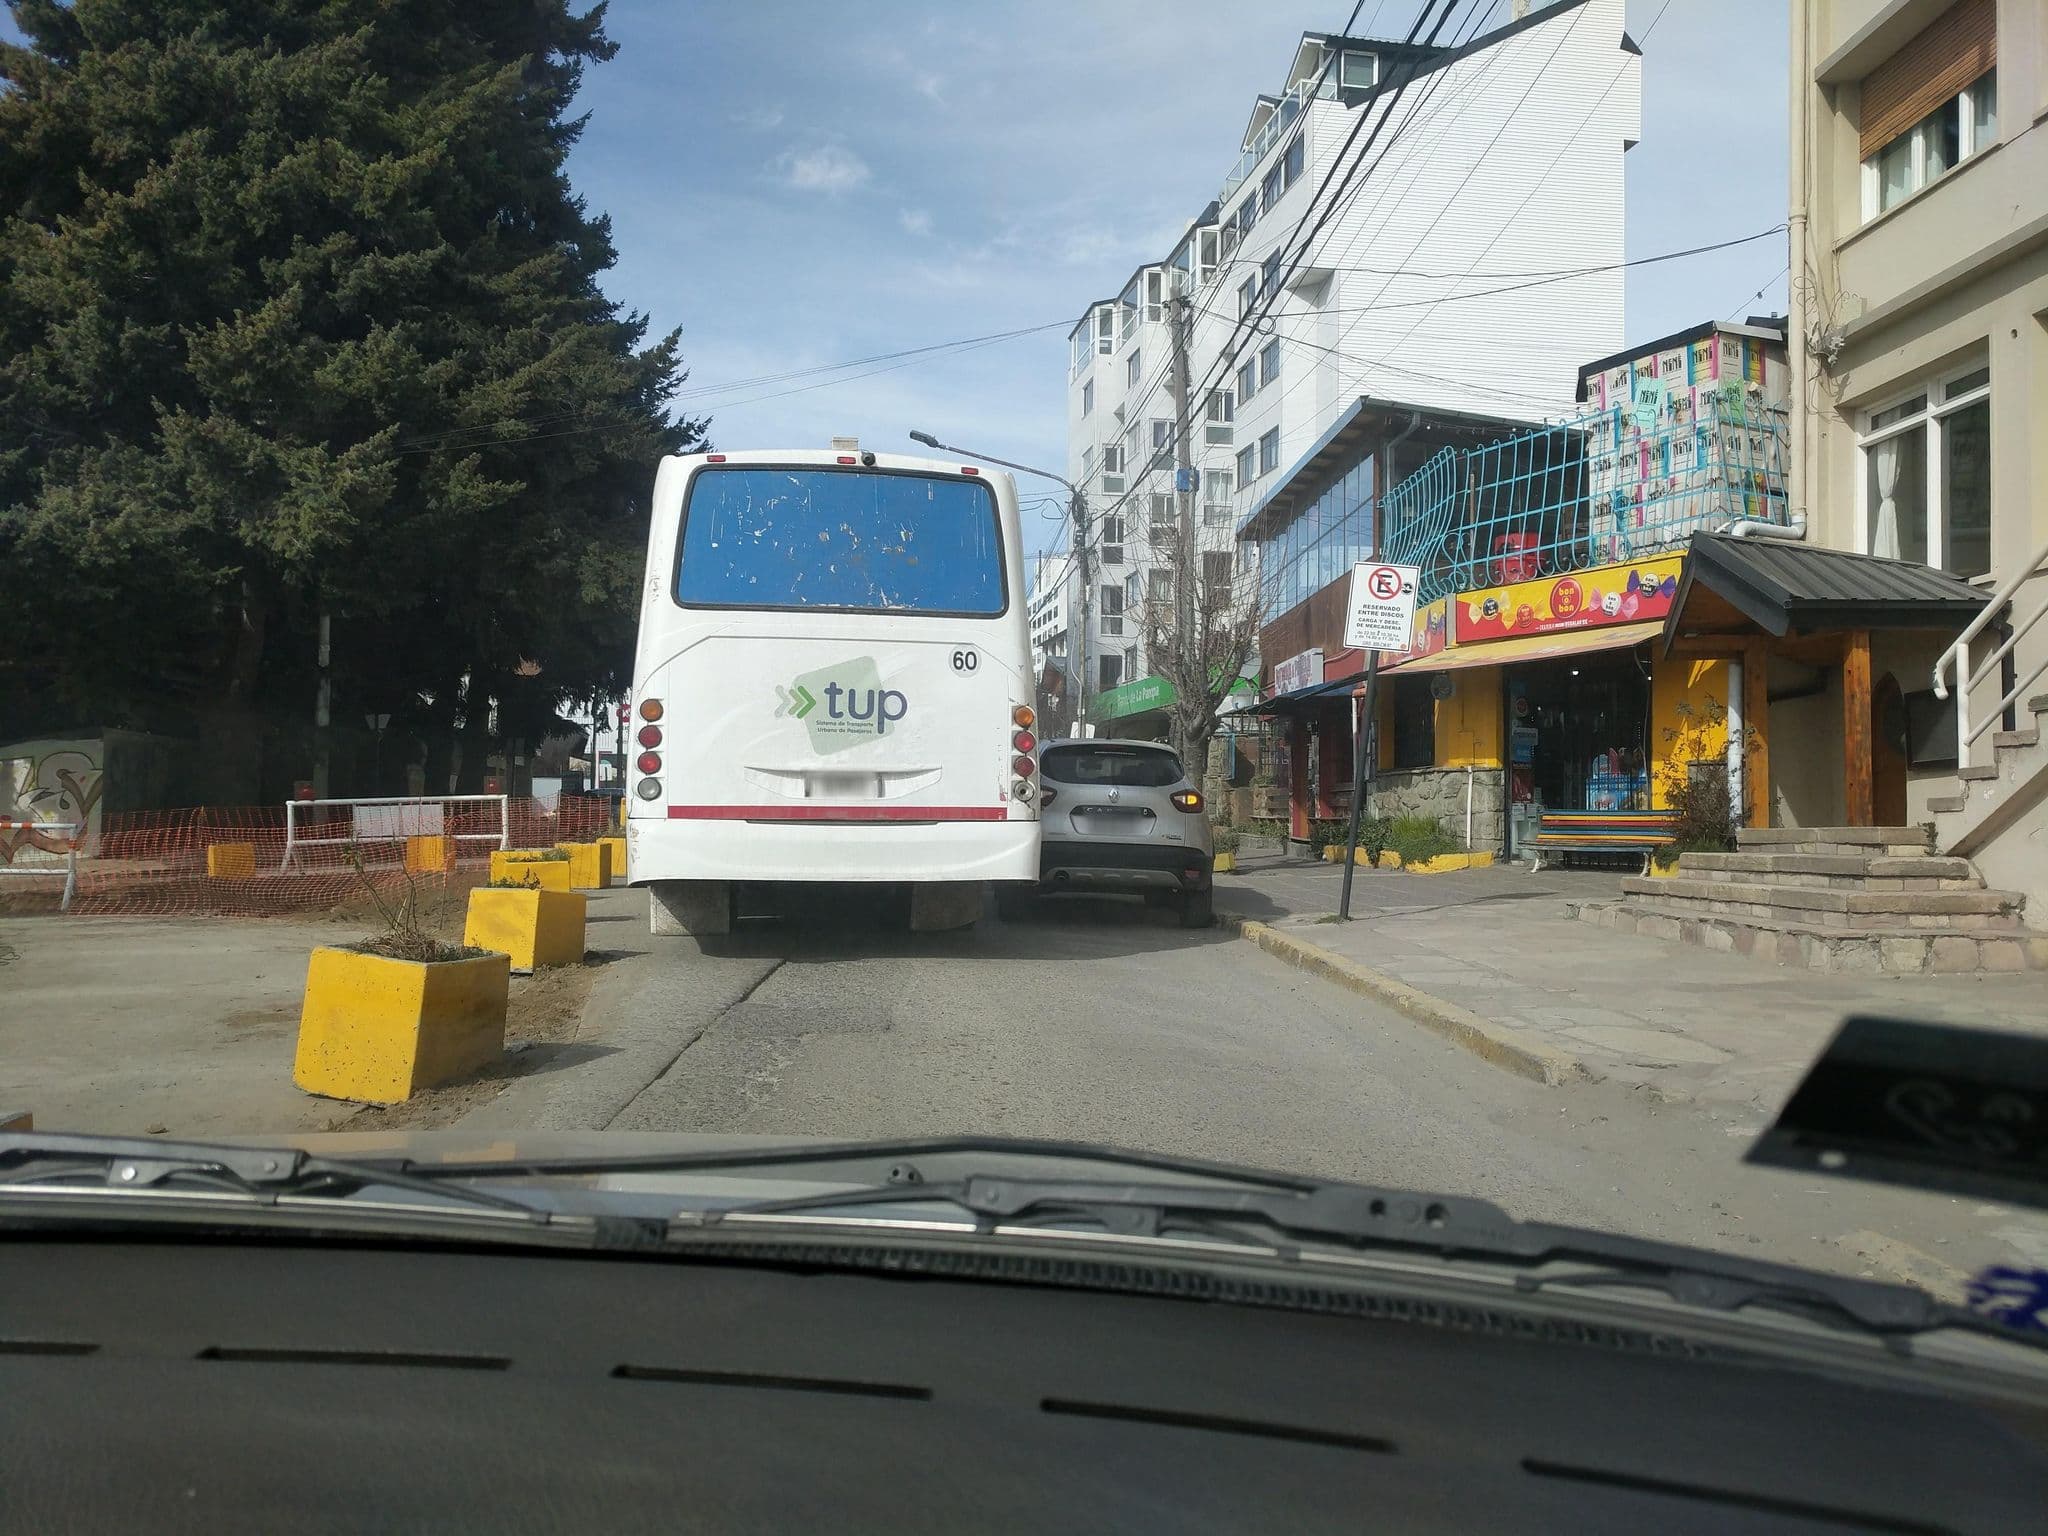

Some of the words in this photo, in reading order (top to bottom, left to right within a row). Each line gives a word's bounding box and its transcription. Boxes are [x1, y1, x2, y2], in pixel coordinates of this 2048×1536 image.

[1558, 587, 1575, 596] bon
[1362, 604, 1401, 612] RESERVADO
[1558, 604, 1575, 612] bon
[1357, 609, 1379, 617] ENTRE
[953, 651, 977, 670] 60
[824, 682, 908, 734] tup
